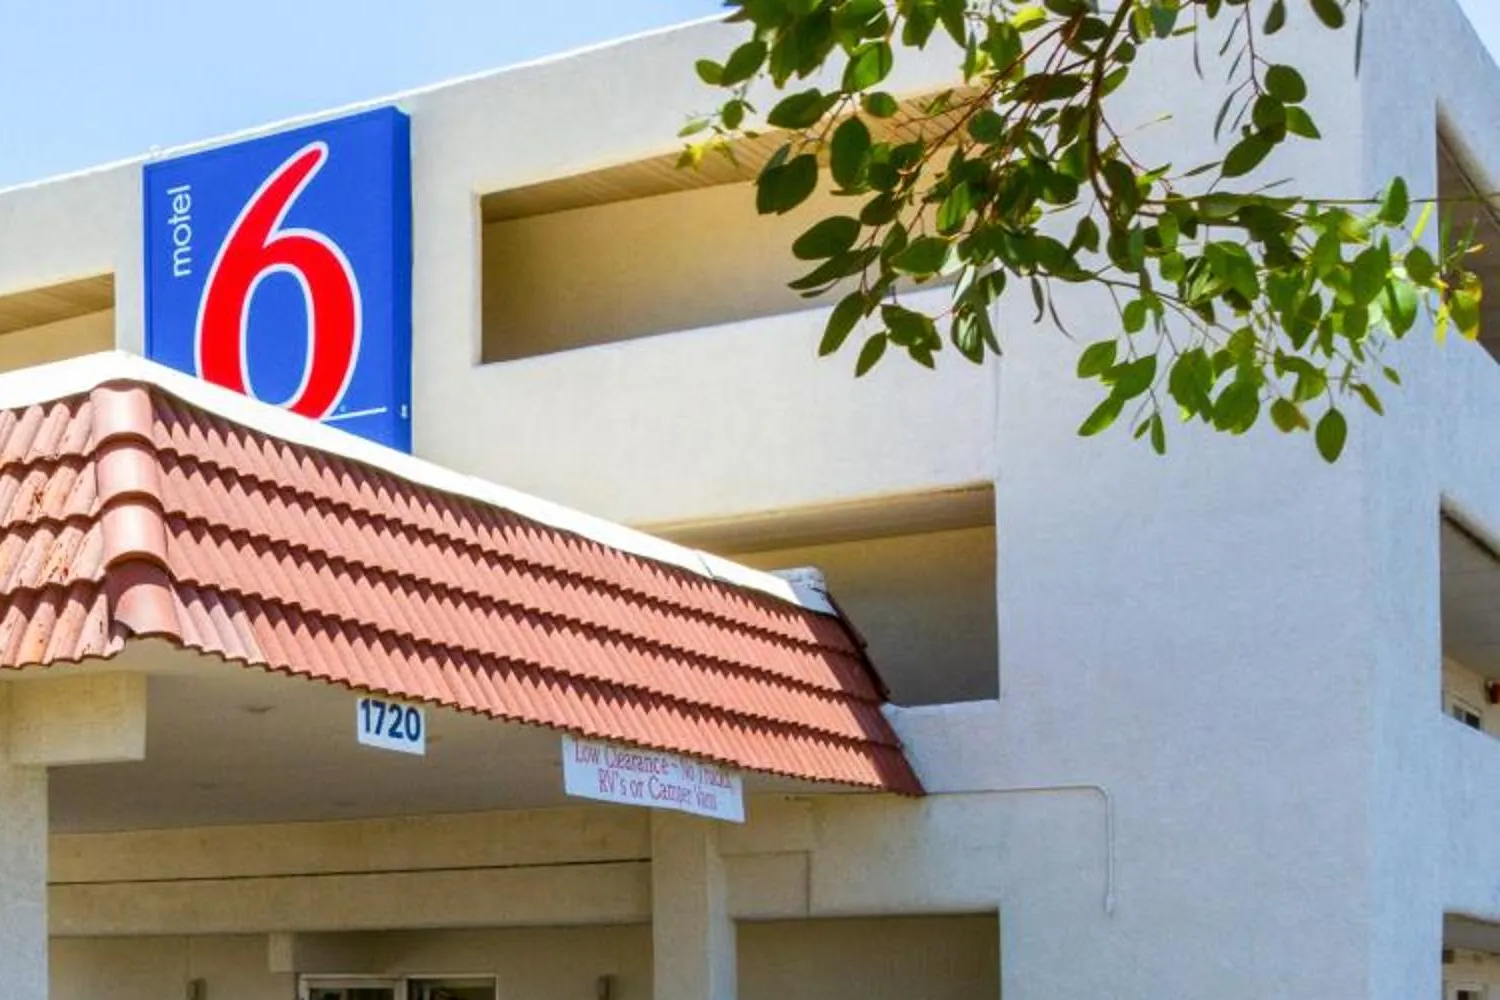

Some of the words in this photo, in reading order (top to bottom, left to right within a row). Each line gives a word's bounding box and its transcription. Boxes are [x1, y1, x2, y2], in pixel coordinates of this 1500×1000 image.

[166, 184, 192, 278] motel
[194, 141, 361, 421] 6
[361, 698, 421, 742] 1720
[574, 739, 599, 765] Low
[631, 779, 644, 799] or
